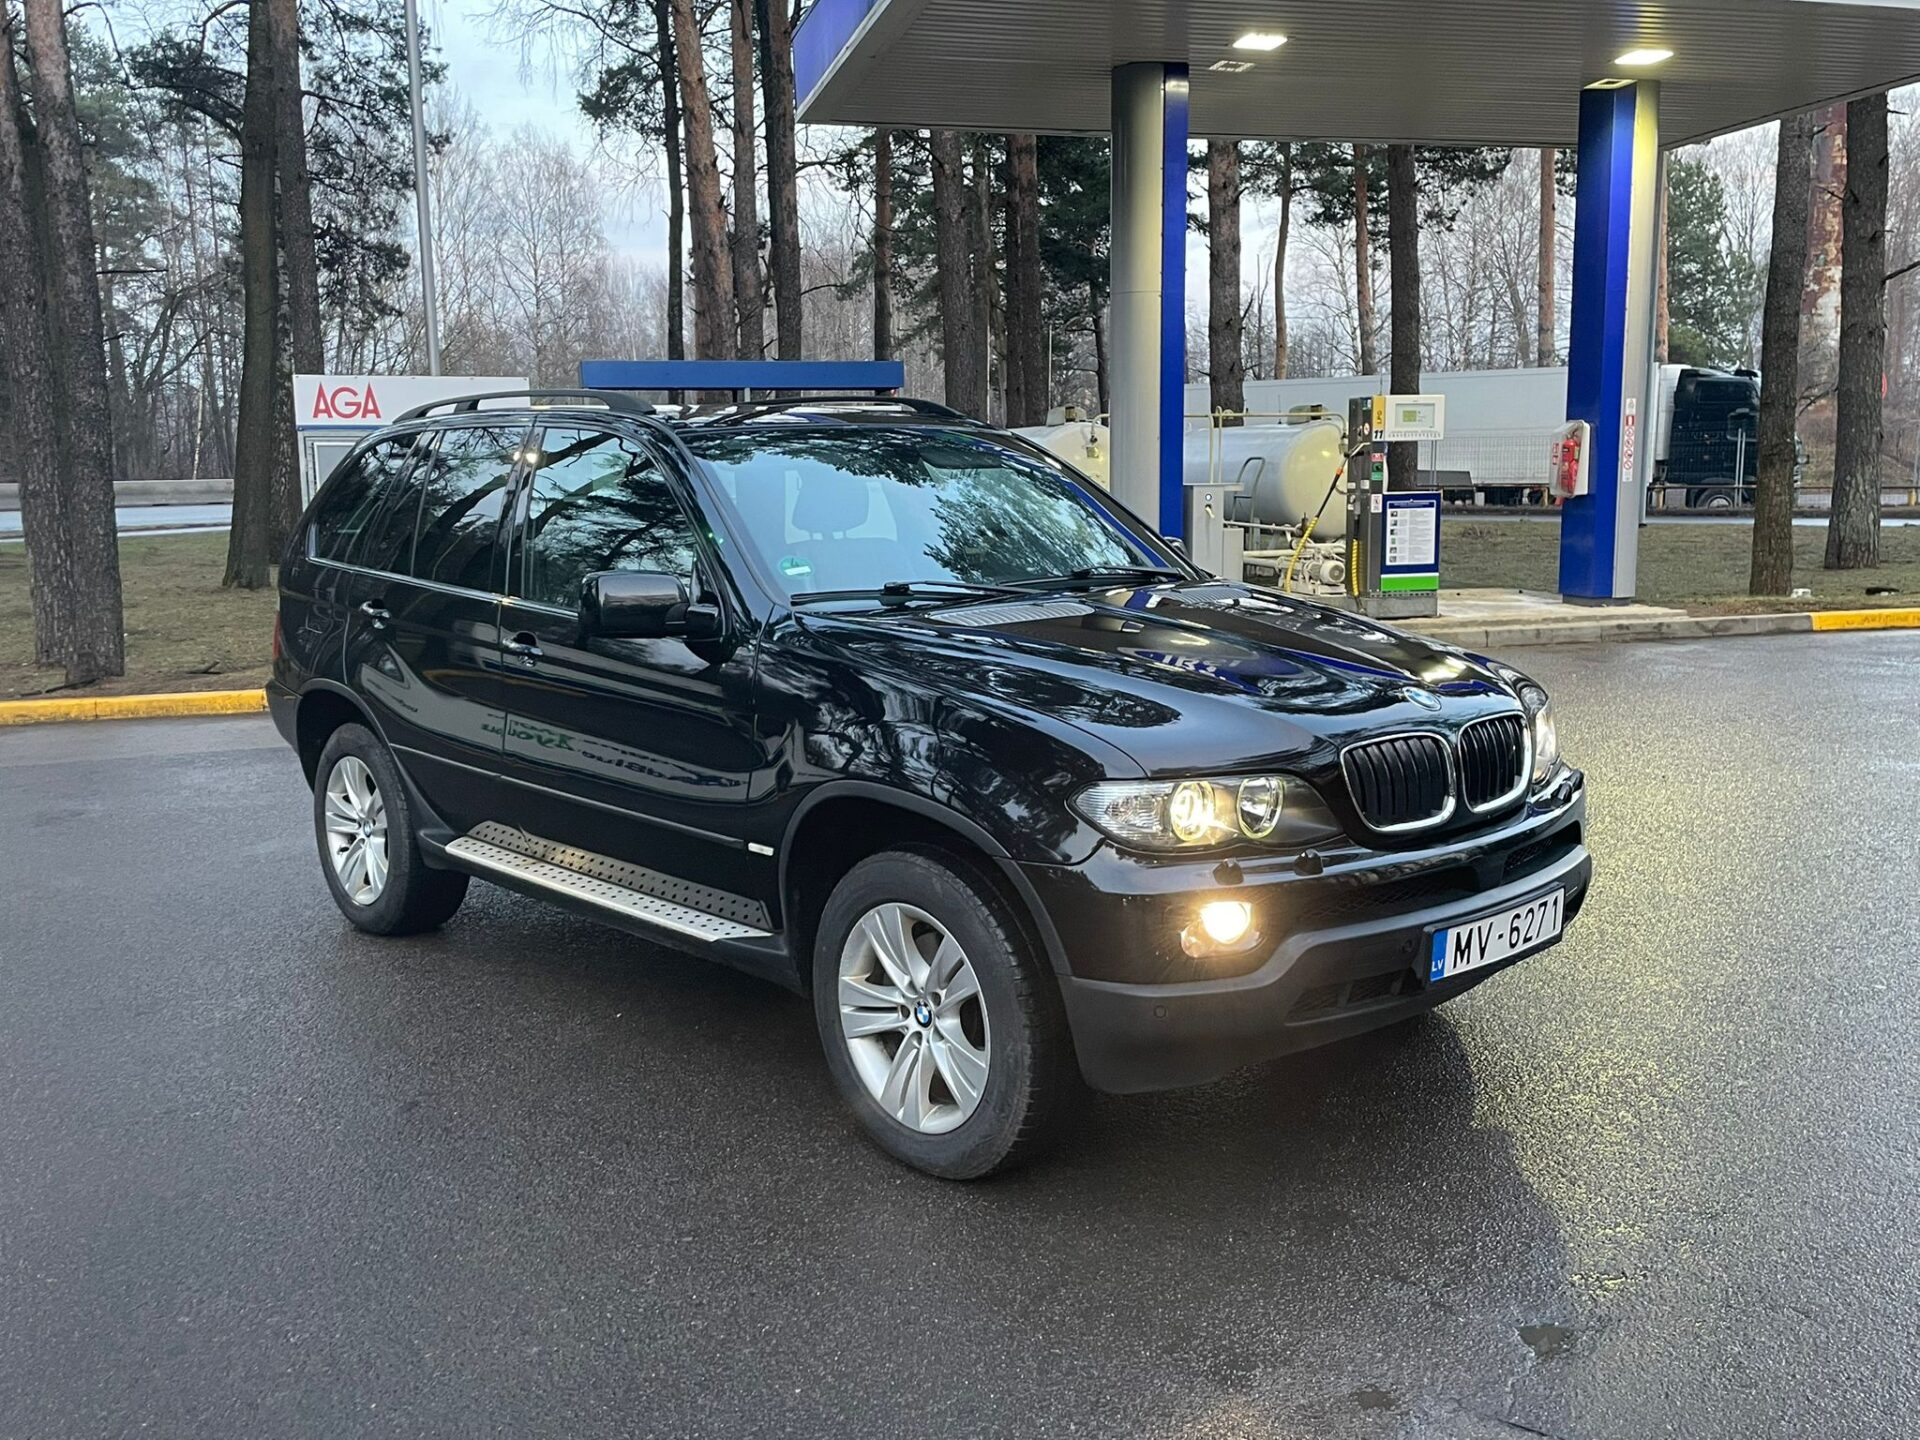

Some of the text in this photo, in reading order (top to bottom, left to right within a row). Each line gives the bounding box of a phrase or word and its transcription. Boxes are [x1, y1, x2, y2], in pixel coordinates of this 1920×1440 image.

[313, 382, 381, 419] AGA
[1374, 429, 1384, 439] 11
[1432, 959, 1444, 972] LV
